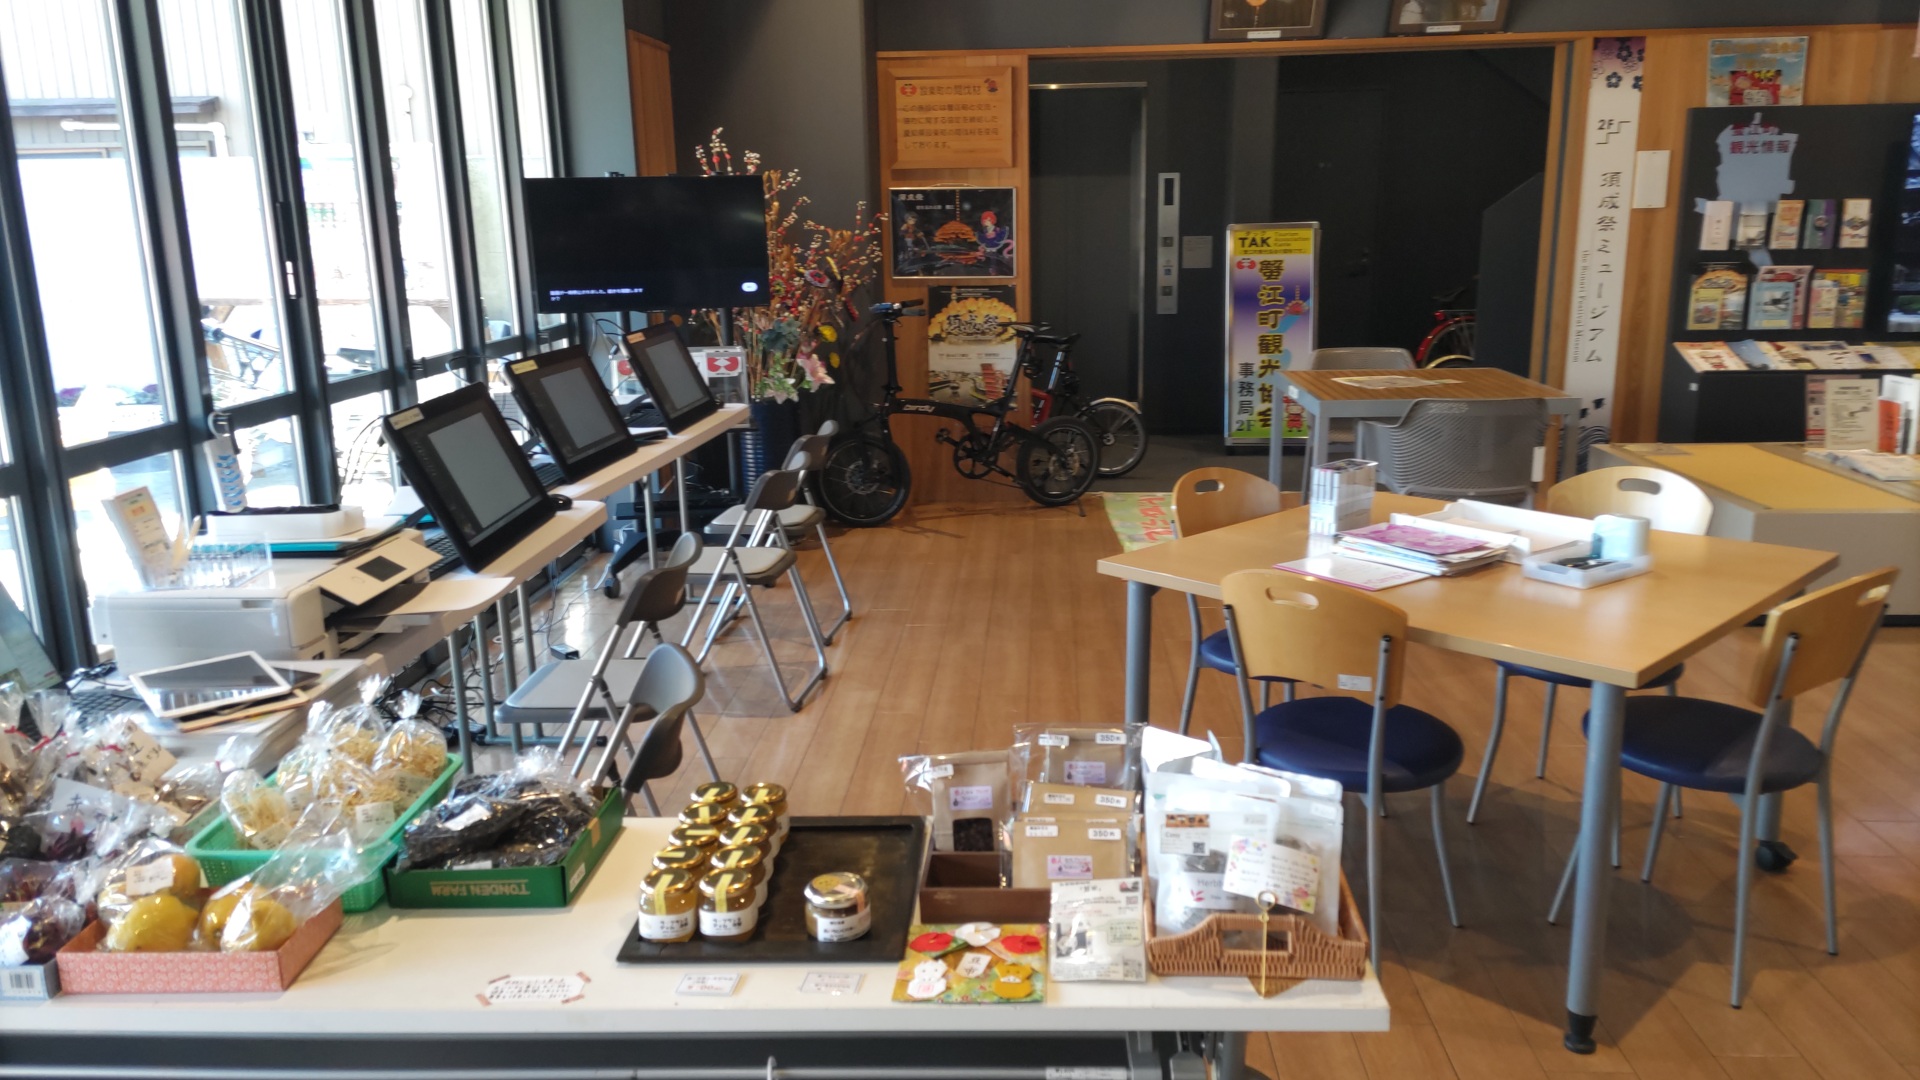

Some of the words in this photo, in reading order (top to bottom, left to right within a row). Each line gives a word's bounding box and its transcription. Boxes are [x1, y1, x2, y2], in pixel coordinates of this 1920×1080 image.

[1597, 119, 1615, 131] 2F
[1730, 140, 1790, 154] 観光情報
[1238, 236, 1271, 248] TAK
[1236, 362, 1255, 416] 事務局
[1235, 419, 1256, 432] 2F
[469, 882, 530, 895] TONDEN
